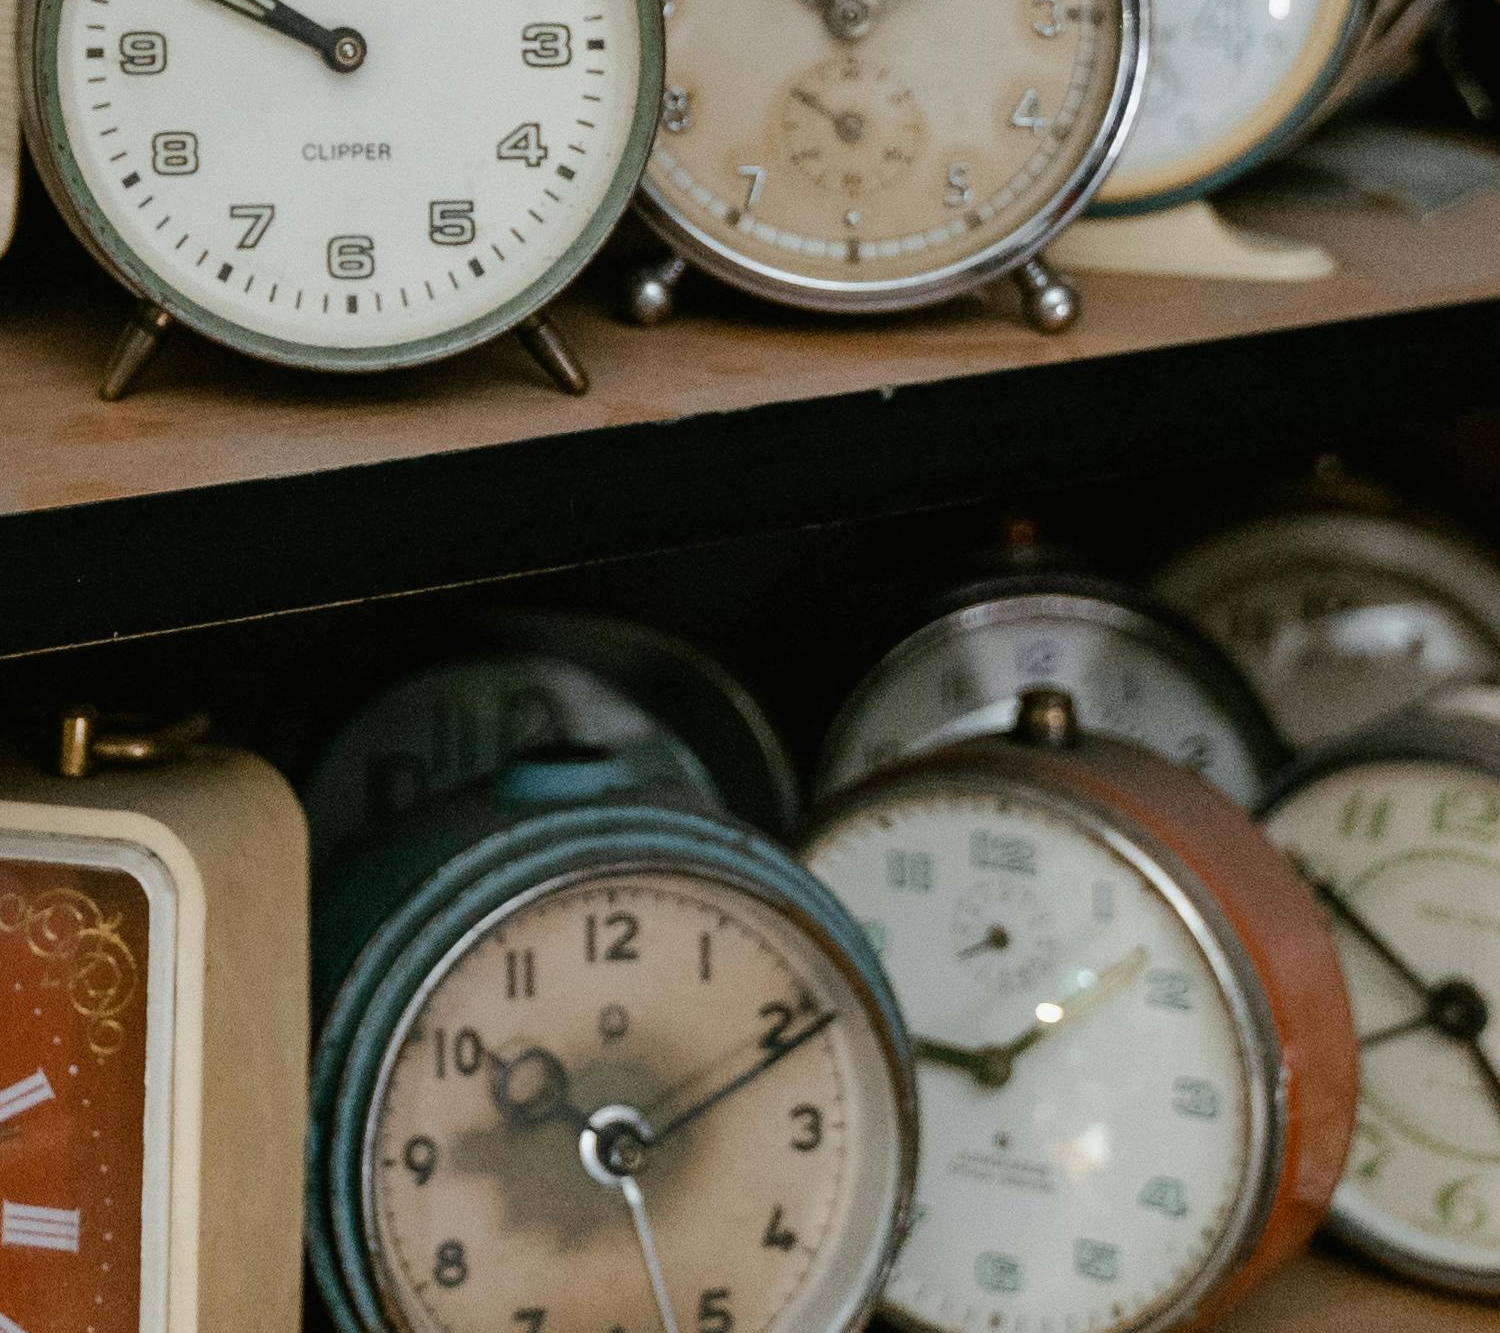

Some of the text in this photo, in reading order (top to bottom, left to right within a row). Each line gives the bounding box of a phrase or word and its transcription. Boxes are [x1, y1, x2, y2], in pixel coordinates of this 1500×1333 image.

[119, 31, 167, 75] 9
[521, 22, 572, 68] 3
[1013, 89, 1045, 134] 4
[151, 131, 200, 176] 8
[302, 142, 391, 161] CLIPPER
[497, 123, 548, 168] 4
[737, 164, 767, 207] 7
[946, 161, 972, 208] 5
[230, 204, 275, 249] 7
[428, 200, 476, 246] 5
[327, 234, 376, 280] 6
[584, 909, 642, 963] 12
[700, 932, 712, 981] 1
[506, 949, 536, 999] 11
[758, 1001, 792, 1054] 2
[435, 1026, 482, 1079] 10
[789, 1105, 824, 1153] 3
[404, 1135, 437, 1185] 9
[0, 1199, 80, 1254] III
[760, 1204, 799, 1253] 4
[433, 1239, 468, 1288] 8
[699, 1288, 734, 1333] 5
